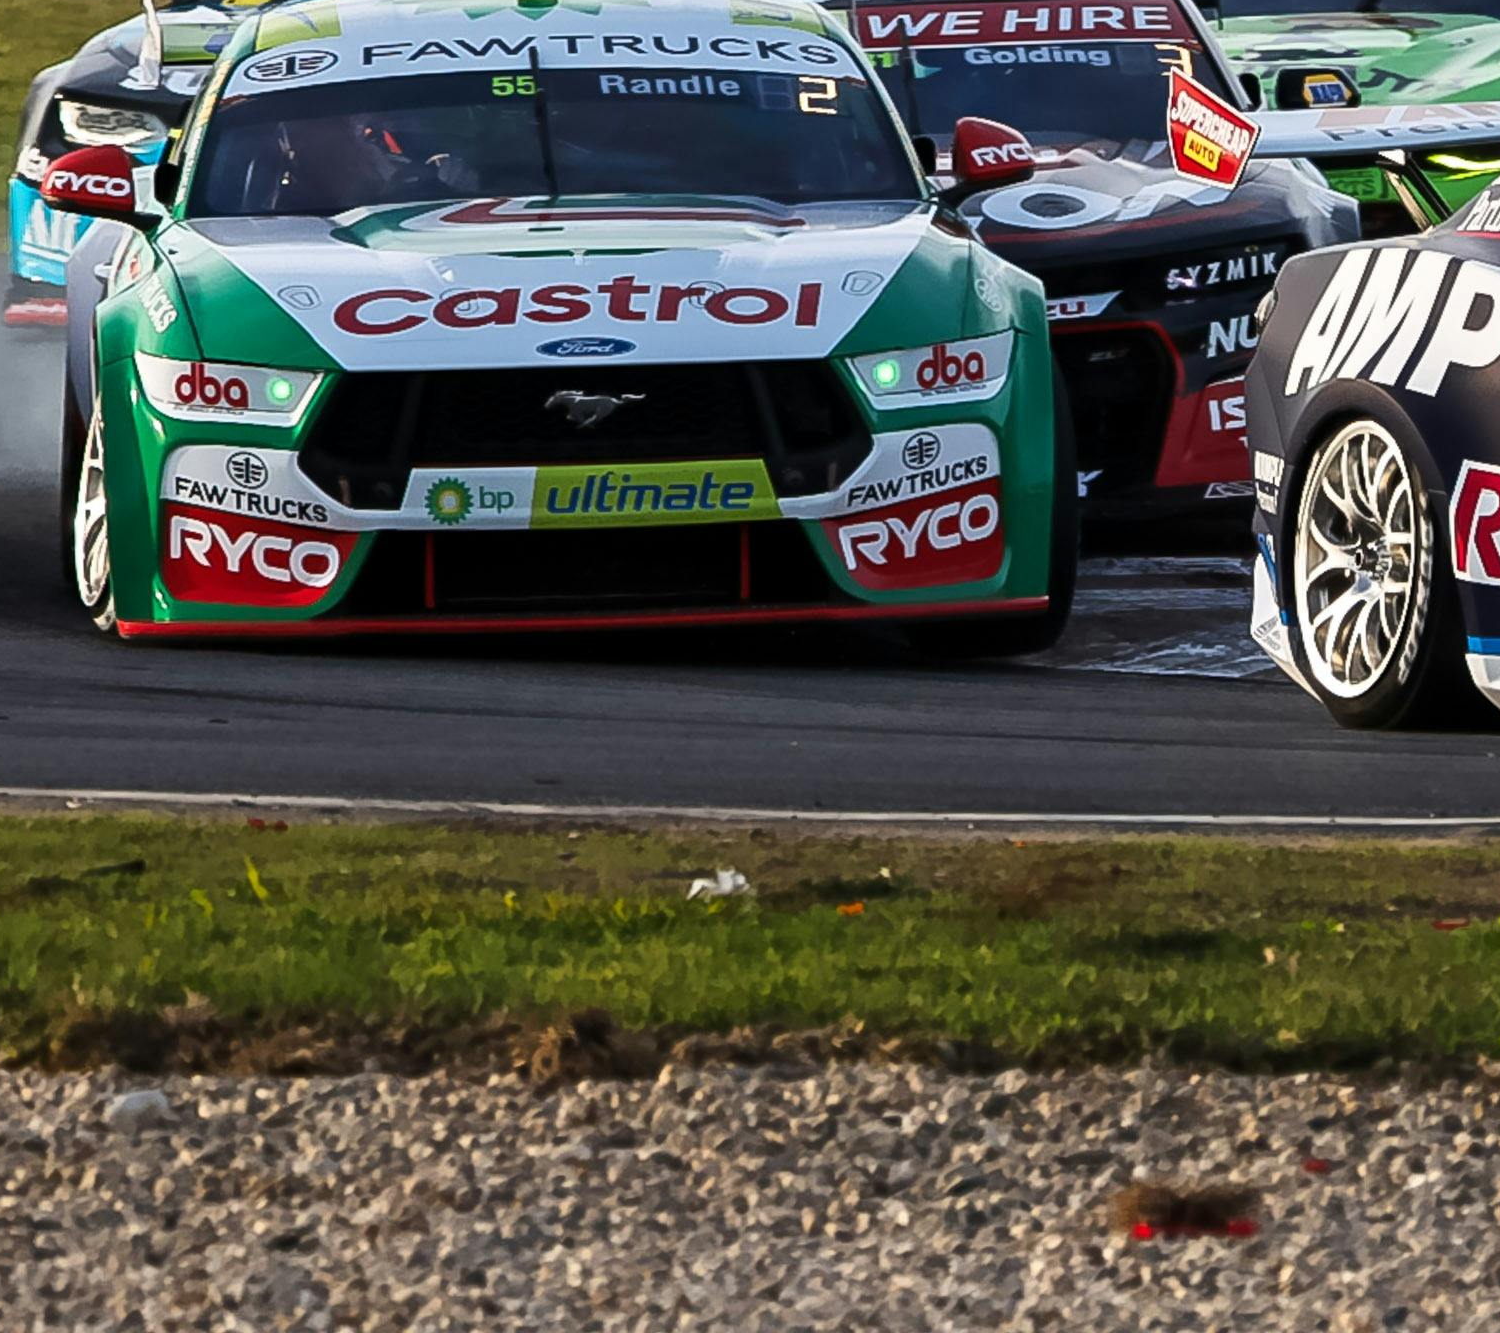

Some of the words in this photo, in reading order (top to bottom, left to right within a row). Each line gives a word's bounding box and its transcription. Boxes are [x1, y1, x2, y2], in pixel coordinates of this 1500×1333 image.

[866, 10, 985, 39] WE
[1002, 5, 1174, 33] HIRE
[362, 35, 538, 66] FAW
[547, 34, 839, 66] TRUCKS
[963, 46, 1112, 68] Golding
[491, 75, 538, 97] 55
[600, 74, 741, 97] Randle
[798, 76, 838, 116] 2
[1171, 89, 1250, 158] SUPERCHEAP
[970, 141, 1035, 169] RYC
[1188, 140, 1216, 164] AUTO
[45, 170, 132, 198] RYCO
[1165, 251, 1279, 291] SYZMIK
[332, 275, 823, 336] Castrol
[555, 339, 616, 358] Ford
[916, 343, 986, 390] dba
[174, 362, 250, 409] dba
[174, 476, 229, 506] FAW
[227, 488, 329, 524] TRUCKS
[477, 486, 516, 513] bp
[546, 470, 755, 515] ultimate
[846, 478, 901, 508] FAW
[898, 455, 989, 493] TRUCKS
[169, 515, 340, 589] RYCO
[837, 493, 1000, 572] RYCO
